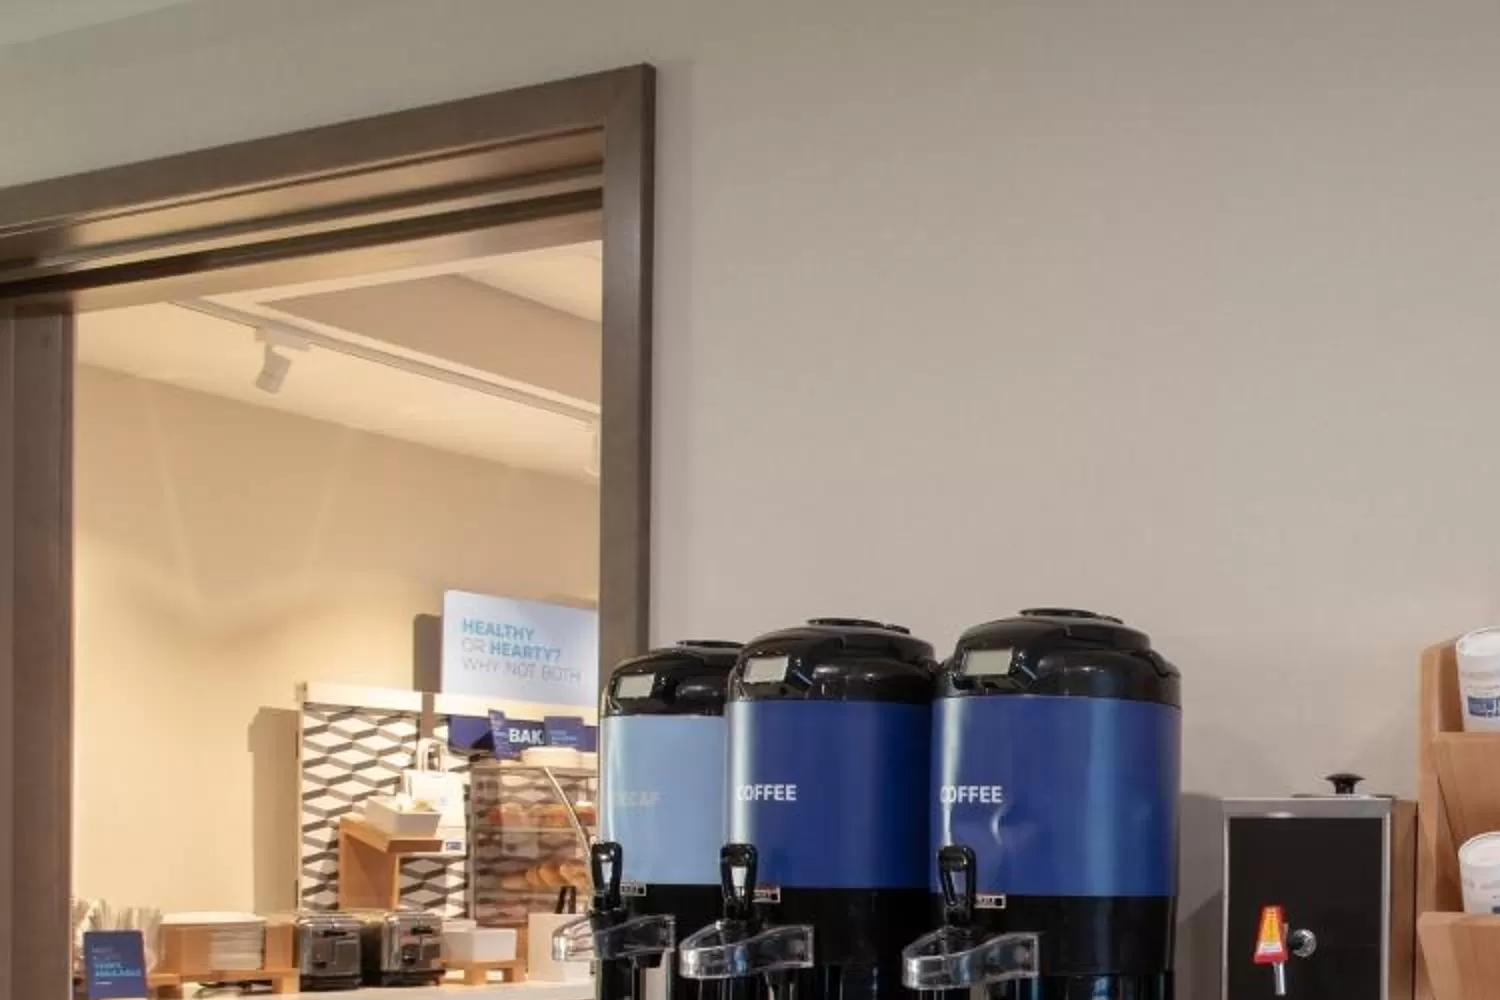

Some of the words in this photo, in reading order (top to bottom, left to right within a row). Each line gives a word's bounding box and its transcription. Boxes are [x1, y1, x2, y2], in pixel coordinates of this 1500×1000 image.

[462, 618, 534, 641] HEALTHY
[461, 637, 486, 653] OR
[489, 640, 561, 663] HEARTY?
[462, 657, 499, 672] WHY
[504, 660, 535, 679] NOT
[542, 667, 581, 684] BOTH
[737, 784, 797, 801] COFFEE
[940, 786, 1002, 803] COFFEE
